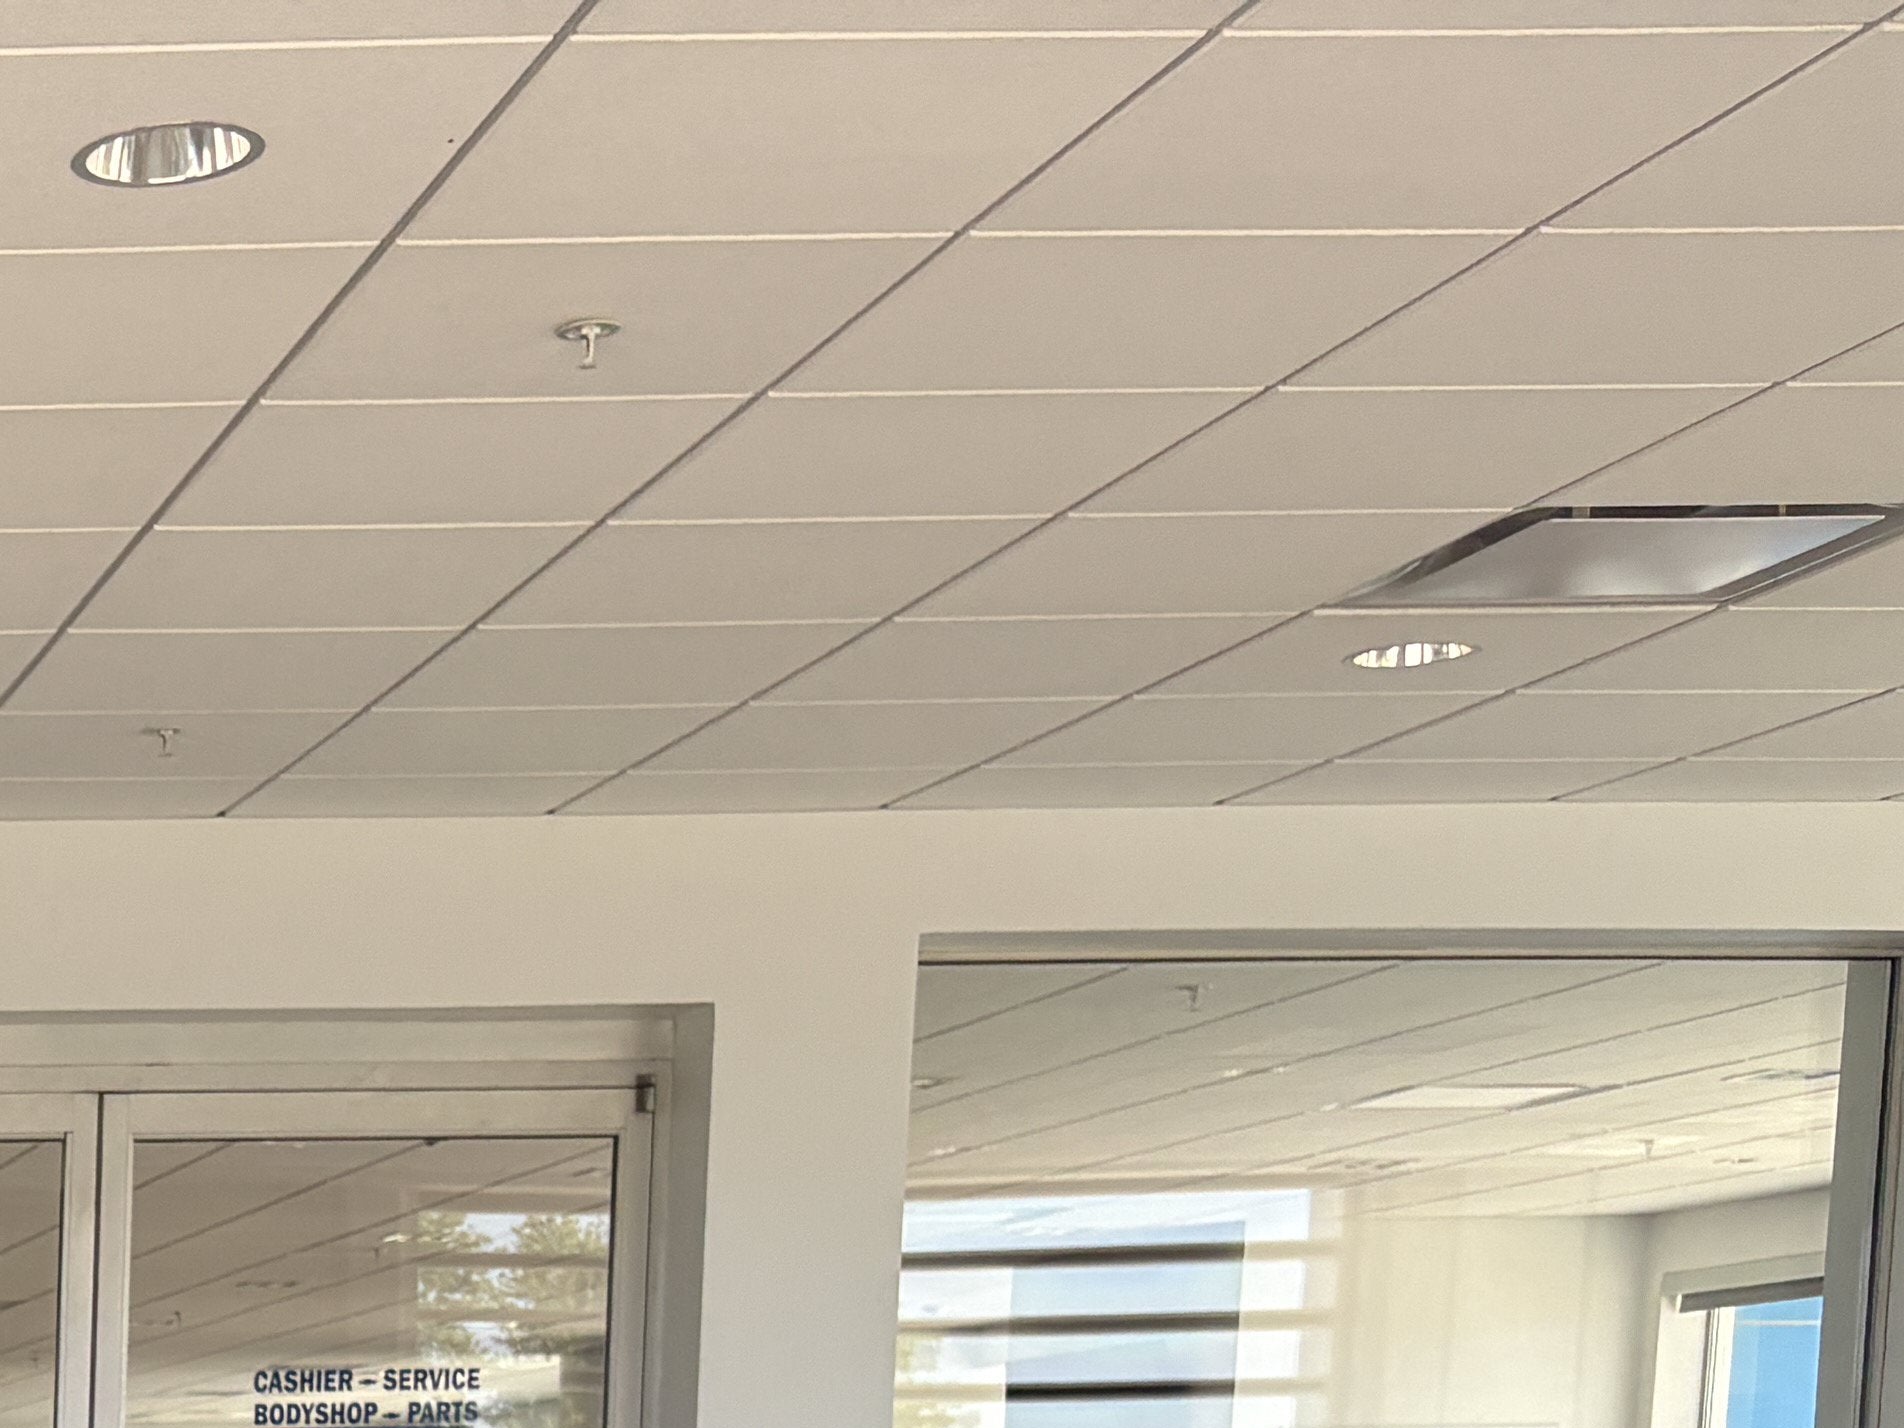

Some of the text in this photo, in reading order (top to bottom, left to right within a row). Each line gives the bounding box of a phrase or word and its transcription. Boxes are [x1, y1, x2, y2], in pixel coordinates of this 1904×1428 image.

[254, 1368, 481, 1393] CASHIER SERVICE
[254, 1401, 479, 1426] BODYSHOP PARTS
